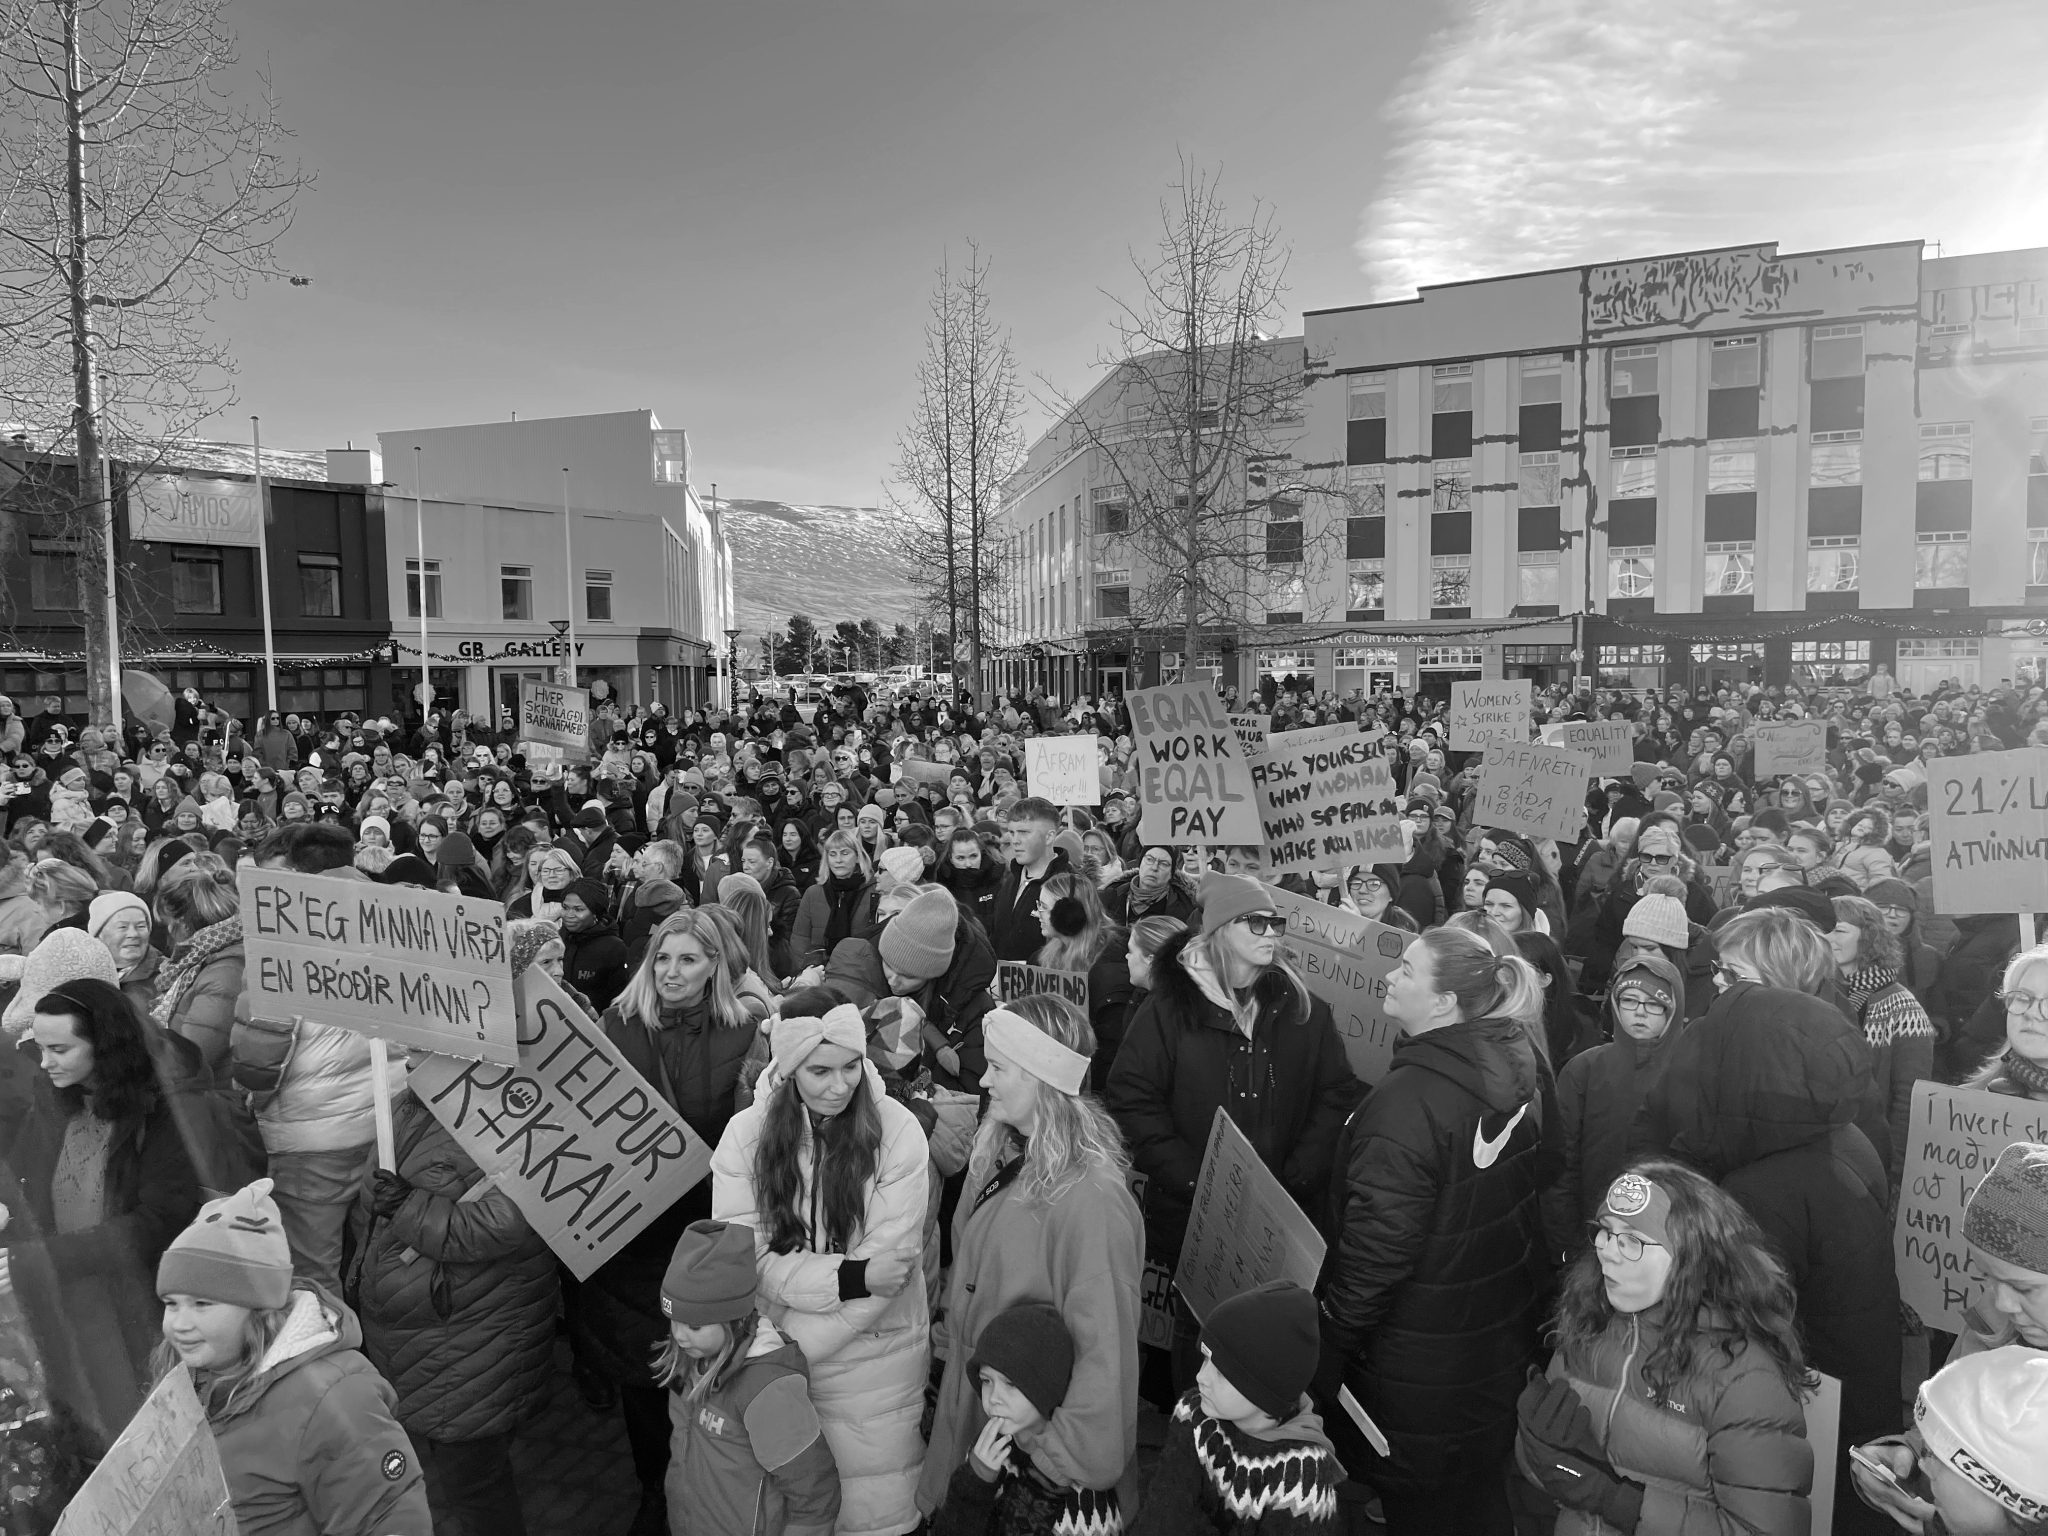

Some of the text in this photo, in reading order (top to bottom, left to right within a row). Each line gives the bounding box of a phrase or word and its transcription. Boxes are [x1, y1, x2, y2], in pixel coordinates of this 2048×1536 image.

[168, 493, 230, 527] VAMOS
[459, 642, 584, 657] GB GALLERY
[1345, 635, 1382, 644] CURRY
[1387, 635, 1425, 643] HOUSE
[535, 687, 564, 706] HVER
[1463, 688, 1521, 709] WOMEN'S
[1130, 690, 1229, 737] EQAL
[1473, 712, 1512, 725] STRIKE
[1149, 734, 1230, 763] WORK
[1569, 725, 1628, 743] EQUALITY
[1144, 763, 1245, 804] EQAL
[1251, 760, 1297, 790] ASK
[1269, 765, 1390, 808] WHY WOMAN
[1171, 806, 1226, 838] PAY
[1264, 813, 1304, 840] WHO
[1311, 799, 1377, 827] SPEAK
[1271, 838, 1316, 867] MAKE
[1322, 835, 1352, 855] YOU
[261, 957, 294, 994] EN
[516, 999, 687, 1182] STELPUR
[1949, 1098, 2012, 1136] hvert
[1913, 1172, 1945, 1199] að
[1906, 1207, 1950, 1239] um
[1227, 1251, 1247, 1290] EN
[700, 1408, 725, 1435] HH
